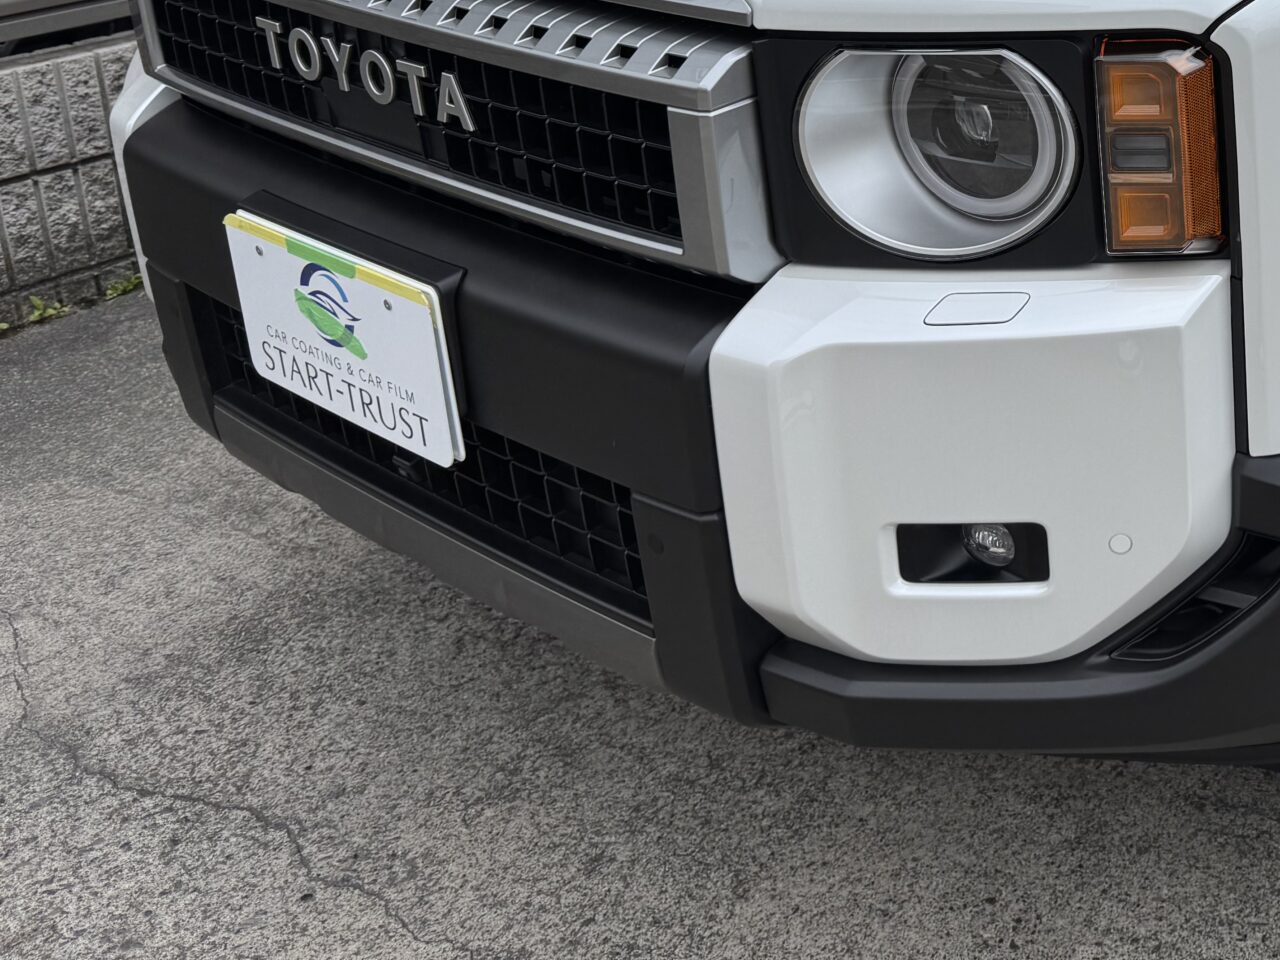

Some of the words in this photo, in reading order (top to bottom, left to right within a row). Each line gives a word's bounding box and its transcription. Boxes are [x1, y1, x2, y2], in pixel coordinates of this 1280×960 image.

[256, 15, 478, 132] TOYOTA
[262, 341, 428, 447] START-TRUST
[266, 324, 287, 344] CAR
[291, 337, 342, 370] COATING
[346, 362, 355, 376] &
[359, 368, 383, 390] CAR
[387, 381, 416, 405] FILM
